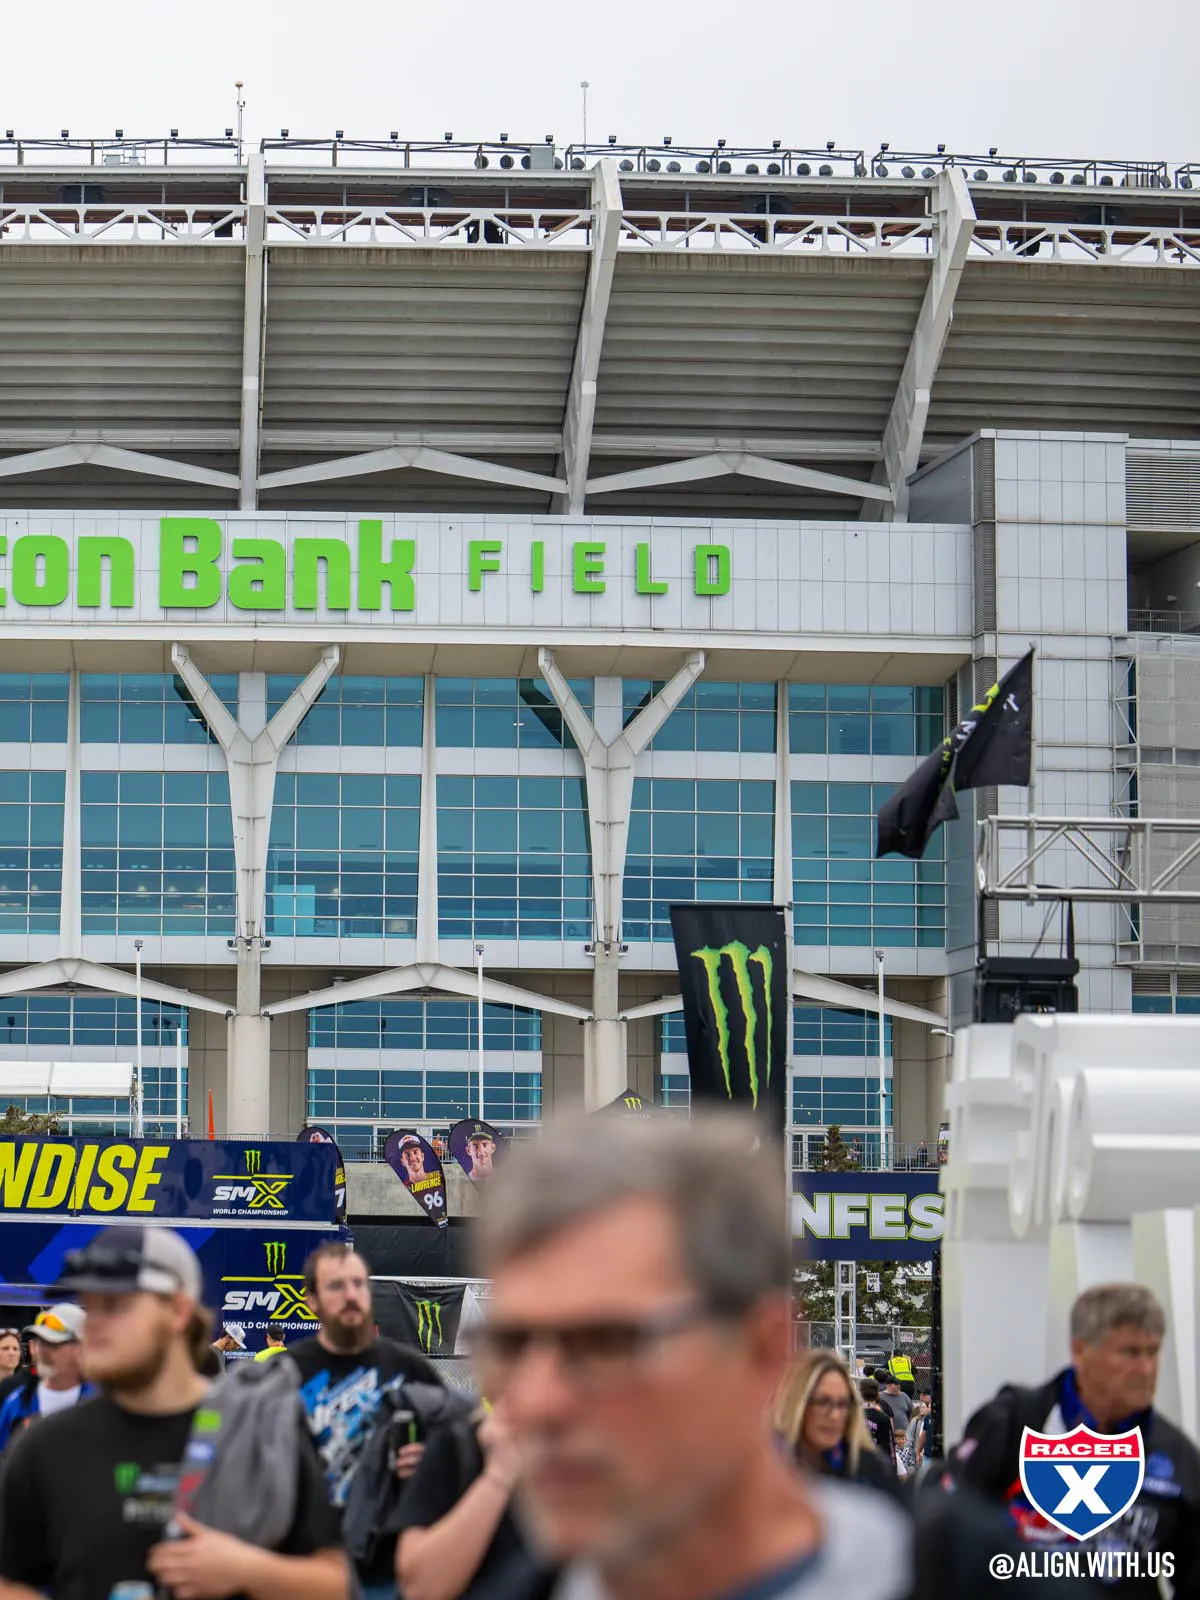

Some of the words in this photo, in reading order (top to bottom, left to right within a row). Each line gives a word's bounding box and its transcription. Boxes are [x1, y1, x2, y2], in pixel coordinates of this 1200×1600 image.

[159, 517, 416, 610] Bank
[469, 540, 731, 595] FIELD
[212, 1180, 289, 1208] SMX
[411, 1177, 441, 1193] LAWRENCE
[423, 1190, 444, 1210] 96
[237, 1208, 289, 1216] CHAMPIONSHIP
[221, 1283, 319, 1320] SMX
[255, 1321, 324, 1330] CHPIONSHIP
